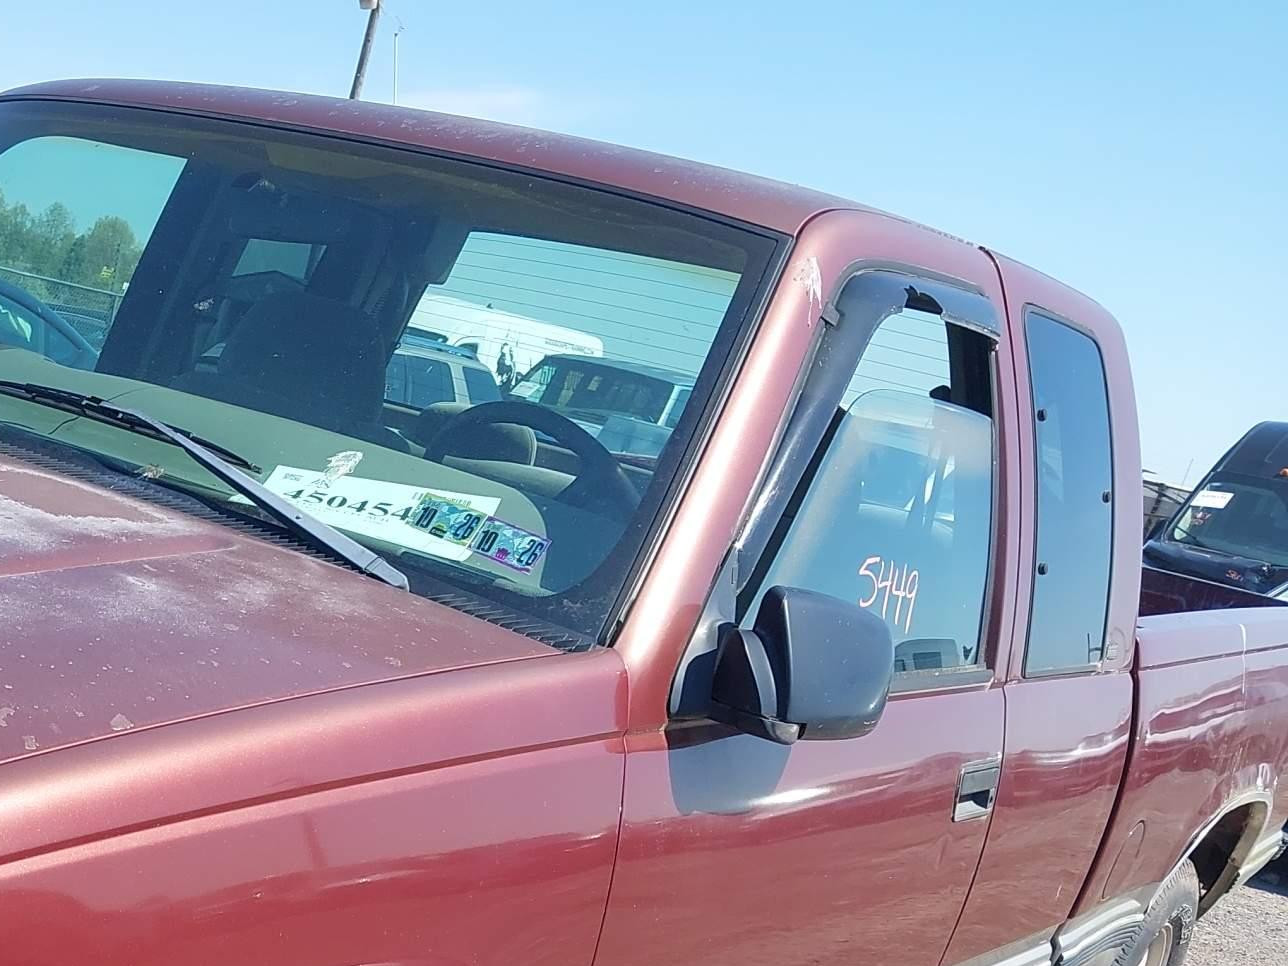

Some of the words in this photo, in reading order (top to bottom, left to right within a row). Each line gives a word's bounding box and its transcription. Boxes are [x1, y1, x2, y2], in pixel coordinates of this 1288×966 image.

[454, 512, 481, 540] 26
[516, 538, 545, 567] 26
[859, 556, 919, 634] 5449
